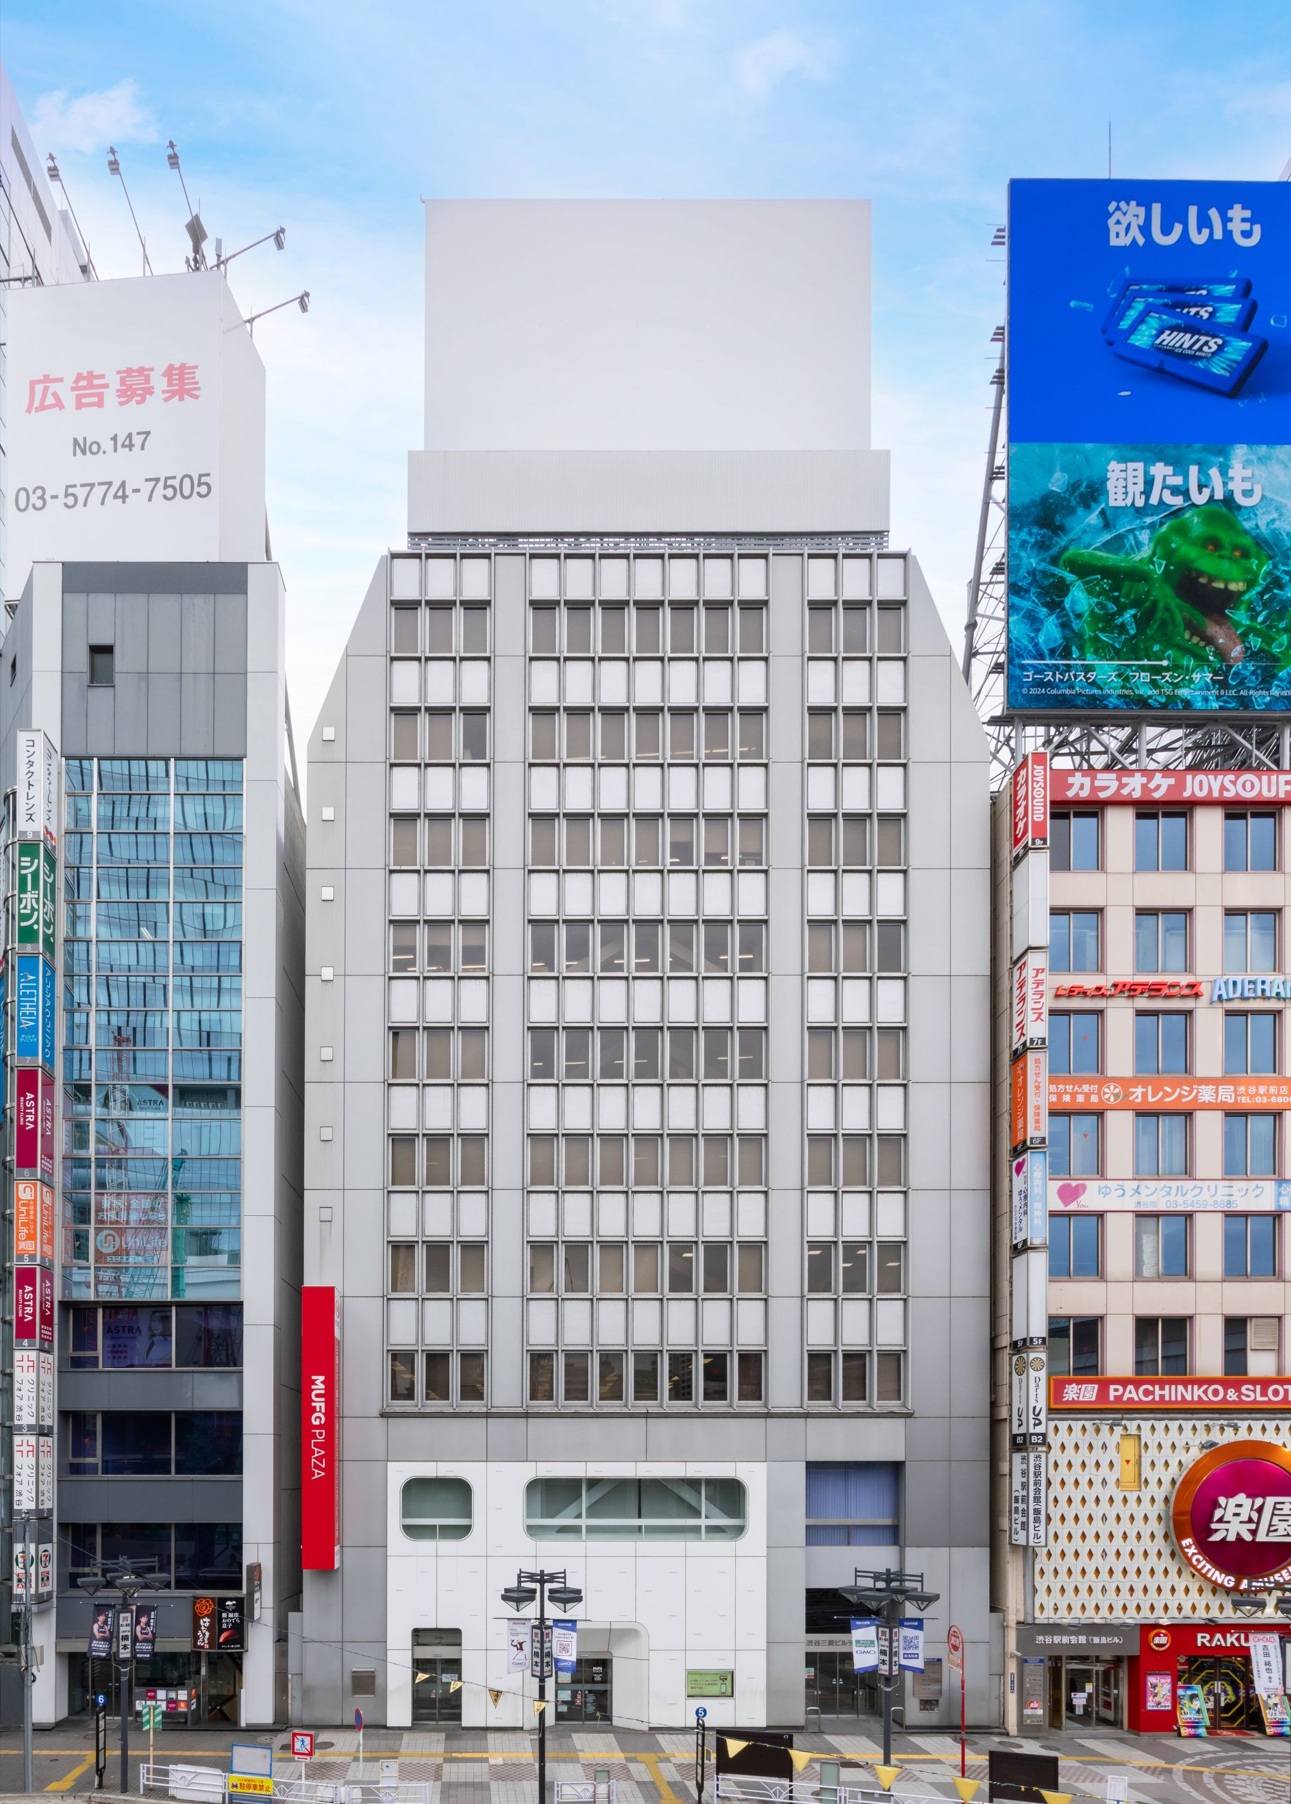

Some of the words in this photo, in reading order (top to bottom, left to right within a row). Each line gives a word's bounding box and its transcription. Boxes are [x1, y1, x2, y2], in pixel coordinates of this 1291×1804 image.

[1107, 200, 1262, 247] 欲しいも
[1154, 330, 1223, 353] HINTS
[25, 362, 201, 414] 広告募集
[72, 430, 151, 457] No.147
[14, 472, 212, 513] 03-5774-7505
[1106, 460, 1262, 507] 観たいも
[25, 739, 36, 823] コンタクトレンズ
[1033, 764, 1045, 822] JOYSOUND
[1066, 772, 1176, 799] カラオケ
[1015, 767, 1027, 838] カラオケ
[19, 971, 37, 1030] ALETHEIA
[1014, 959, 1027, 1045] アデランス
[1030, 967, 1046, 1023] アデランス
[25, 1092, 35, 1130] ASTRA
[1048, 1084, 1099, 1093] 処方せん受付
[1128, 1085, 1235, 1103] オレンジ薬局
[1236, 1085, 1289, 1095] 渋谷駅前店
[1048, 1094, 1099, 1103] 保険薬局
[1097, 1183, 1265, 1199] ゆうメンタルクリニック
[1165, 1200, 1238, 1209] 03-5459-8885
[19, 1200, 29, 1240] UniLife
[24, 1285, 33, 1322] ASTRA
[106, 1325, 142, 1334] ASTRA
[27, 1378, 35, 1418] クリニック
[311, 1375, 326, 1425] MUFG
[1062, 1383, 1099, 1401] 楽園
[1109, 1384, 1225, 1401] PACHINKO
[311, 1429, 326, 1480] PLAZA
[1181, 1537, 1236, 1588] EXCITING
[98, 1695, 104, 1703] 6
[698, 1708, 704, 1717] 5
